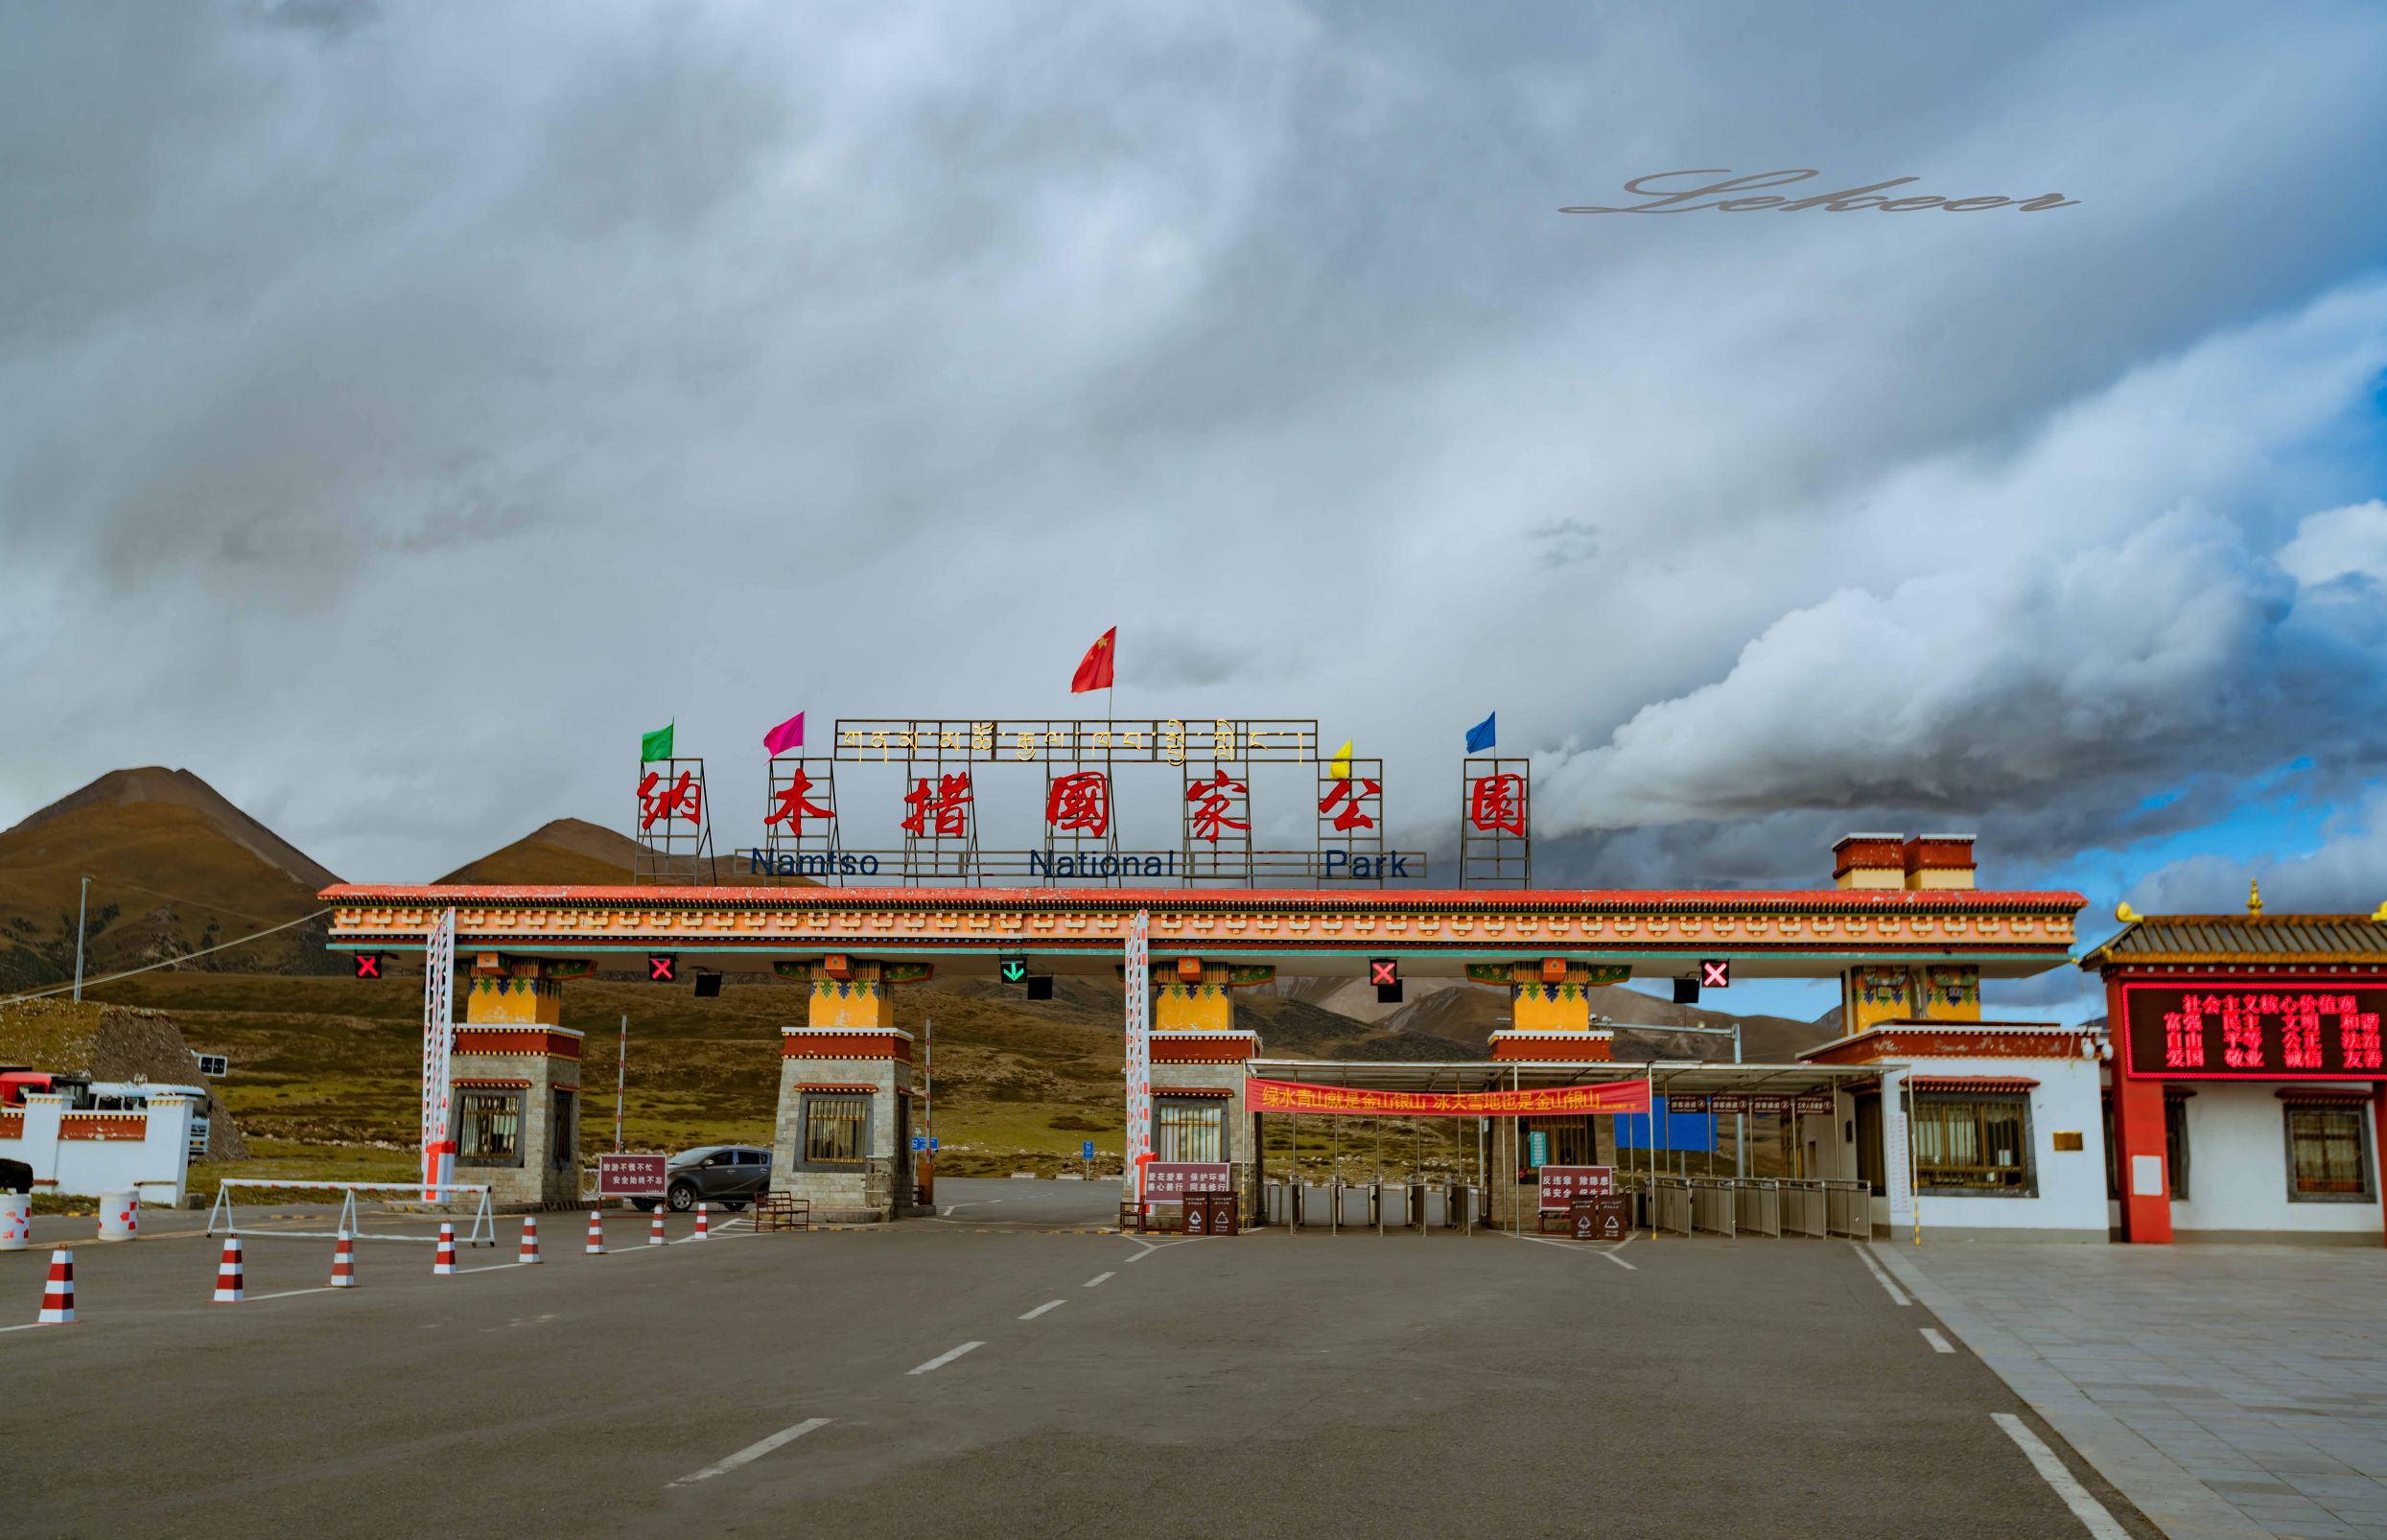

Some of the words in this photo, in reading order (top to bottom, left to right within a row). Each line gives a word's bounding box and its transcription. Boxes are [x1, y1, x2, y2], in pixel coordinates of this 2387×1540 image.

[751, 847, 879, 875] Namtso
[1029, 850, 1175, 877] National
[1325, 850, 1409, 878] Park
[2183, 994, 2358, 1015] 社会主义核心价值观
[2164, 1012, 2203, 1032] 富强
[2223, 1012, 2262, 1032] 民主
[2281, 1013, 2320, 1032] 文明
[2340, 1013, 2380, 1033] 和谐
[2223, 1032, 2262, 1049] 平等
[2282, 1032, 2323, 1050] 公正
[2341, 1032, 2381, 1050] 法治
[2165, 1049, 2205, 1067] 爱国
[2224, 1049, 2264, 1067] 敬业
[2283, 1050, 2323, 1067] 诚信
[2343, 1050, 2383, 1068] 友善
[1262, 1086, 1426, 1110] 绿水青山就是金山银山
[1433, 1089, 1601, 1111] 冰天雪地也是金山银山
[1190, 1173, 1227, 1182] 保护环境
[1542, 1176, 1573, 1185] 反违章
[1579, 1176, 1609, 1186] 除隐患
[1542, 1187, 1572, 1199] 保安全
